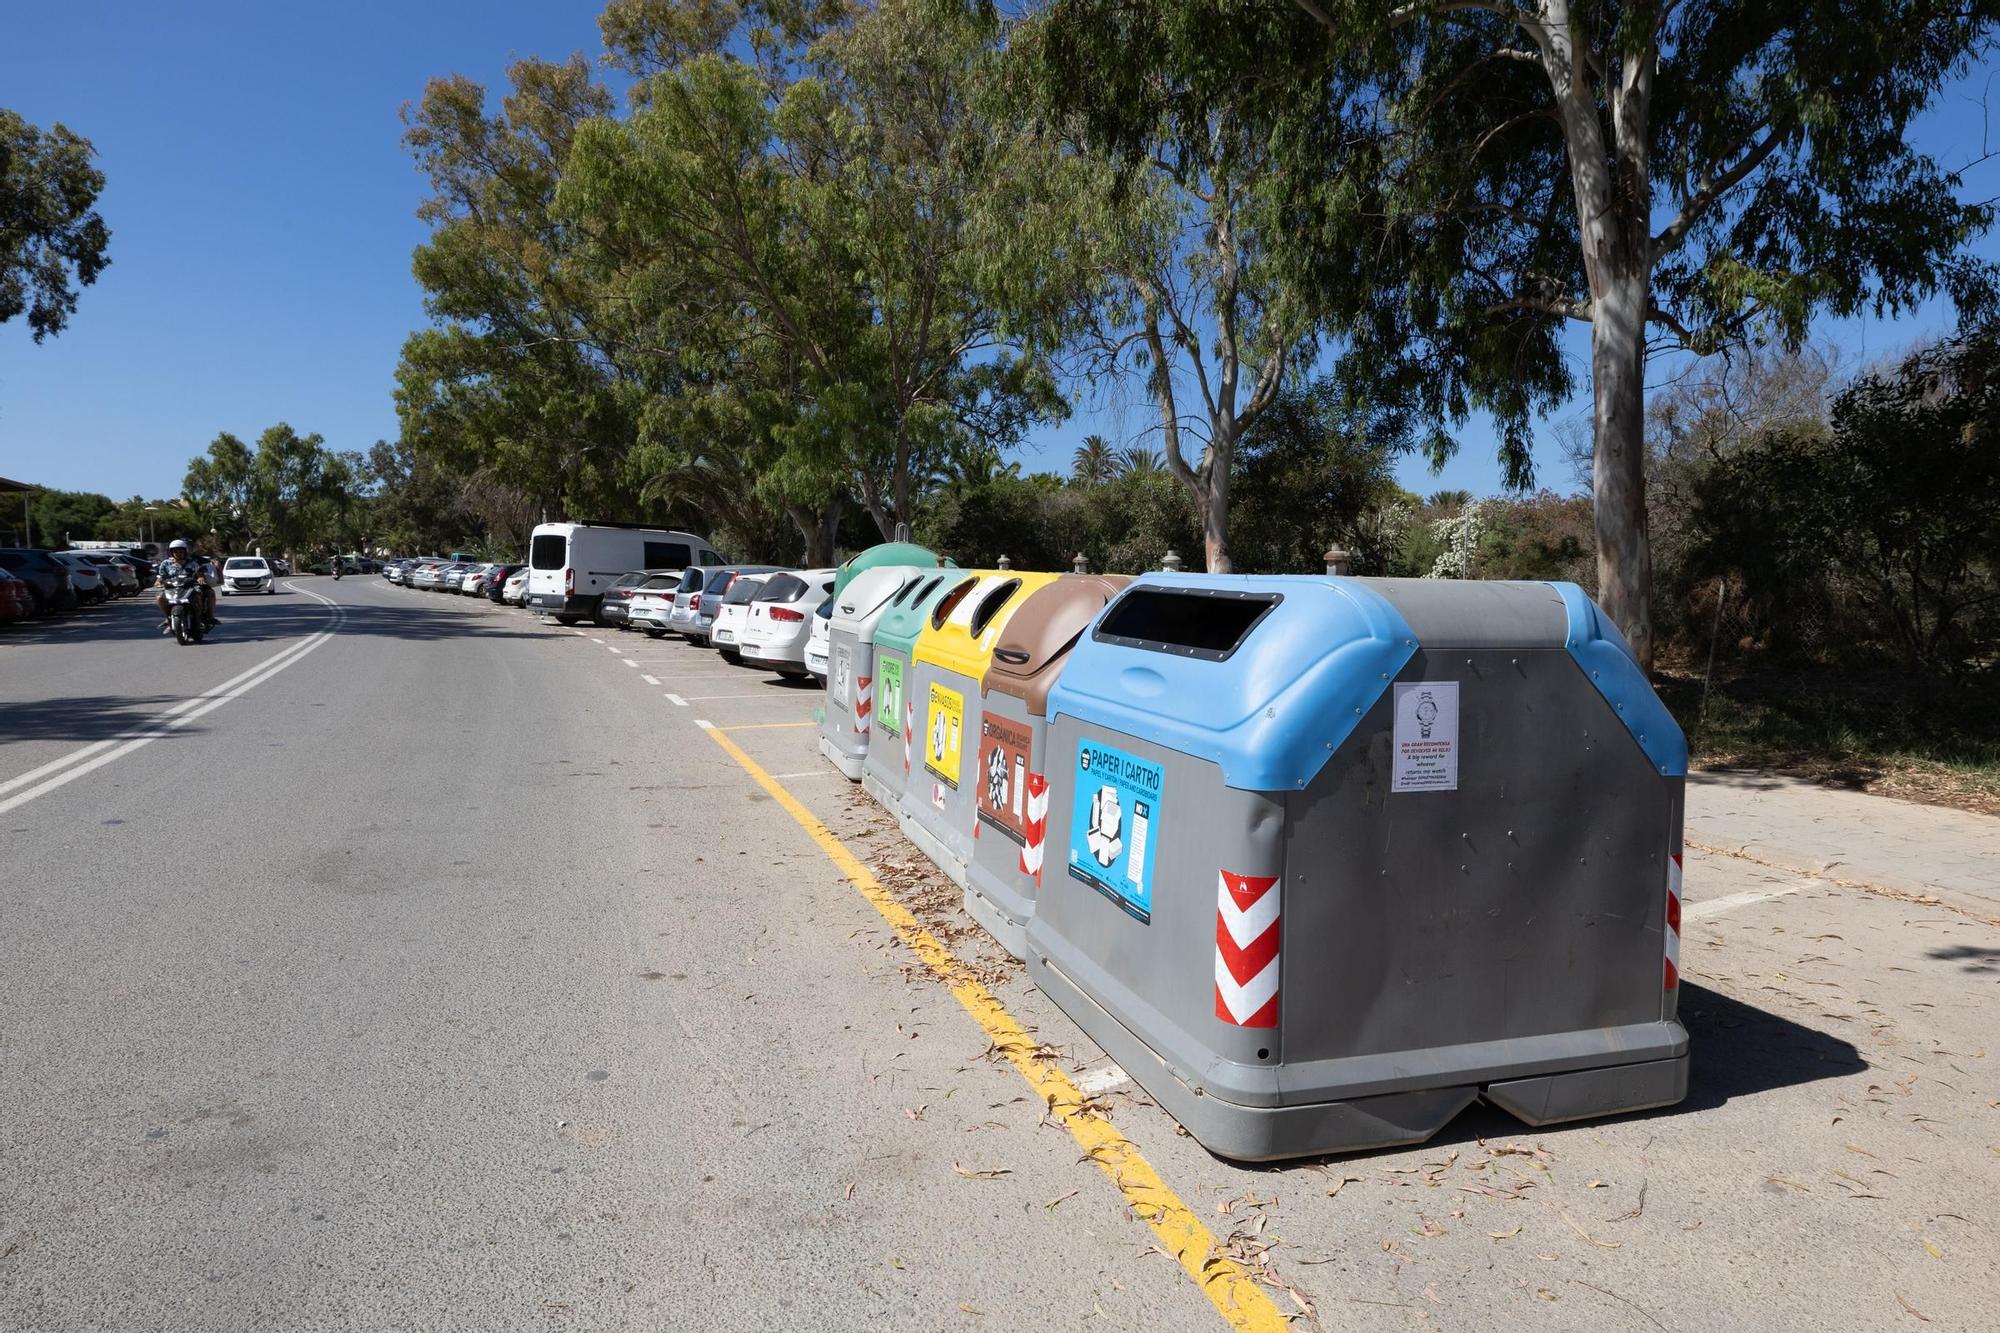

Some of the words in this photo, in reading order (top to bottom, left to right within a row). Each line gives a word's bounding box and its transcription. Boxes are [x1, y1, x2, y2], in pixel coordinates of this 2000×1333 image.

[1091, 750, 1120, 775] PAPER
[1121, 760, 1125, 777] I
[1126, 761, 1160, 791] CARTRÓ
